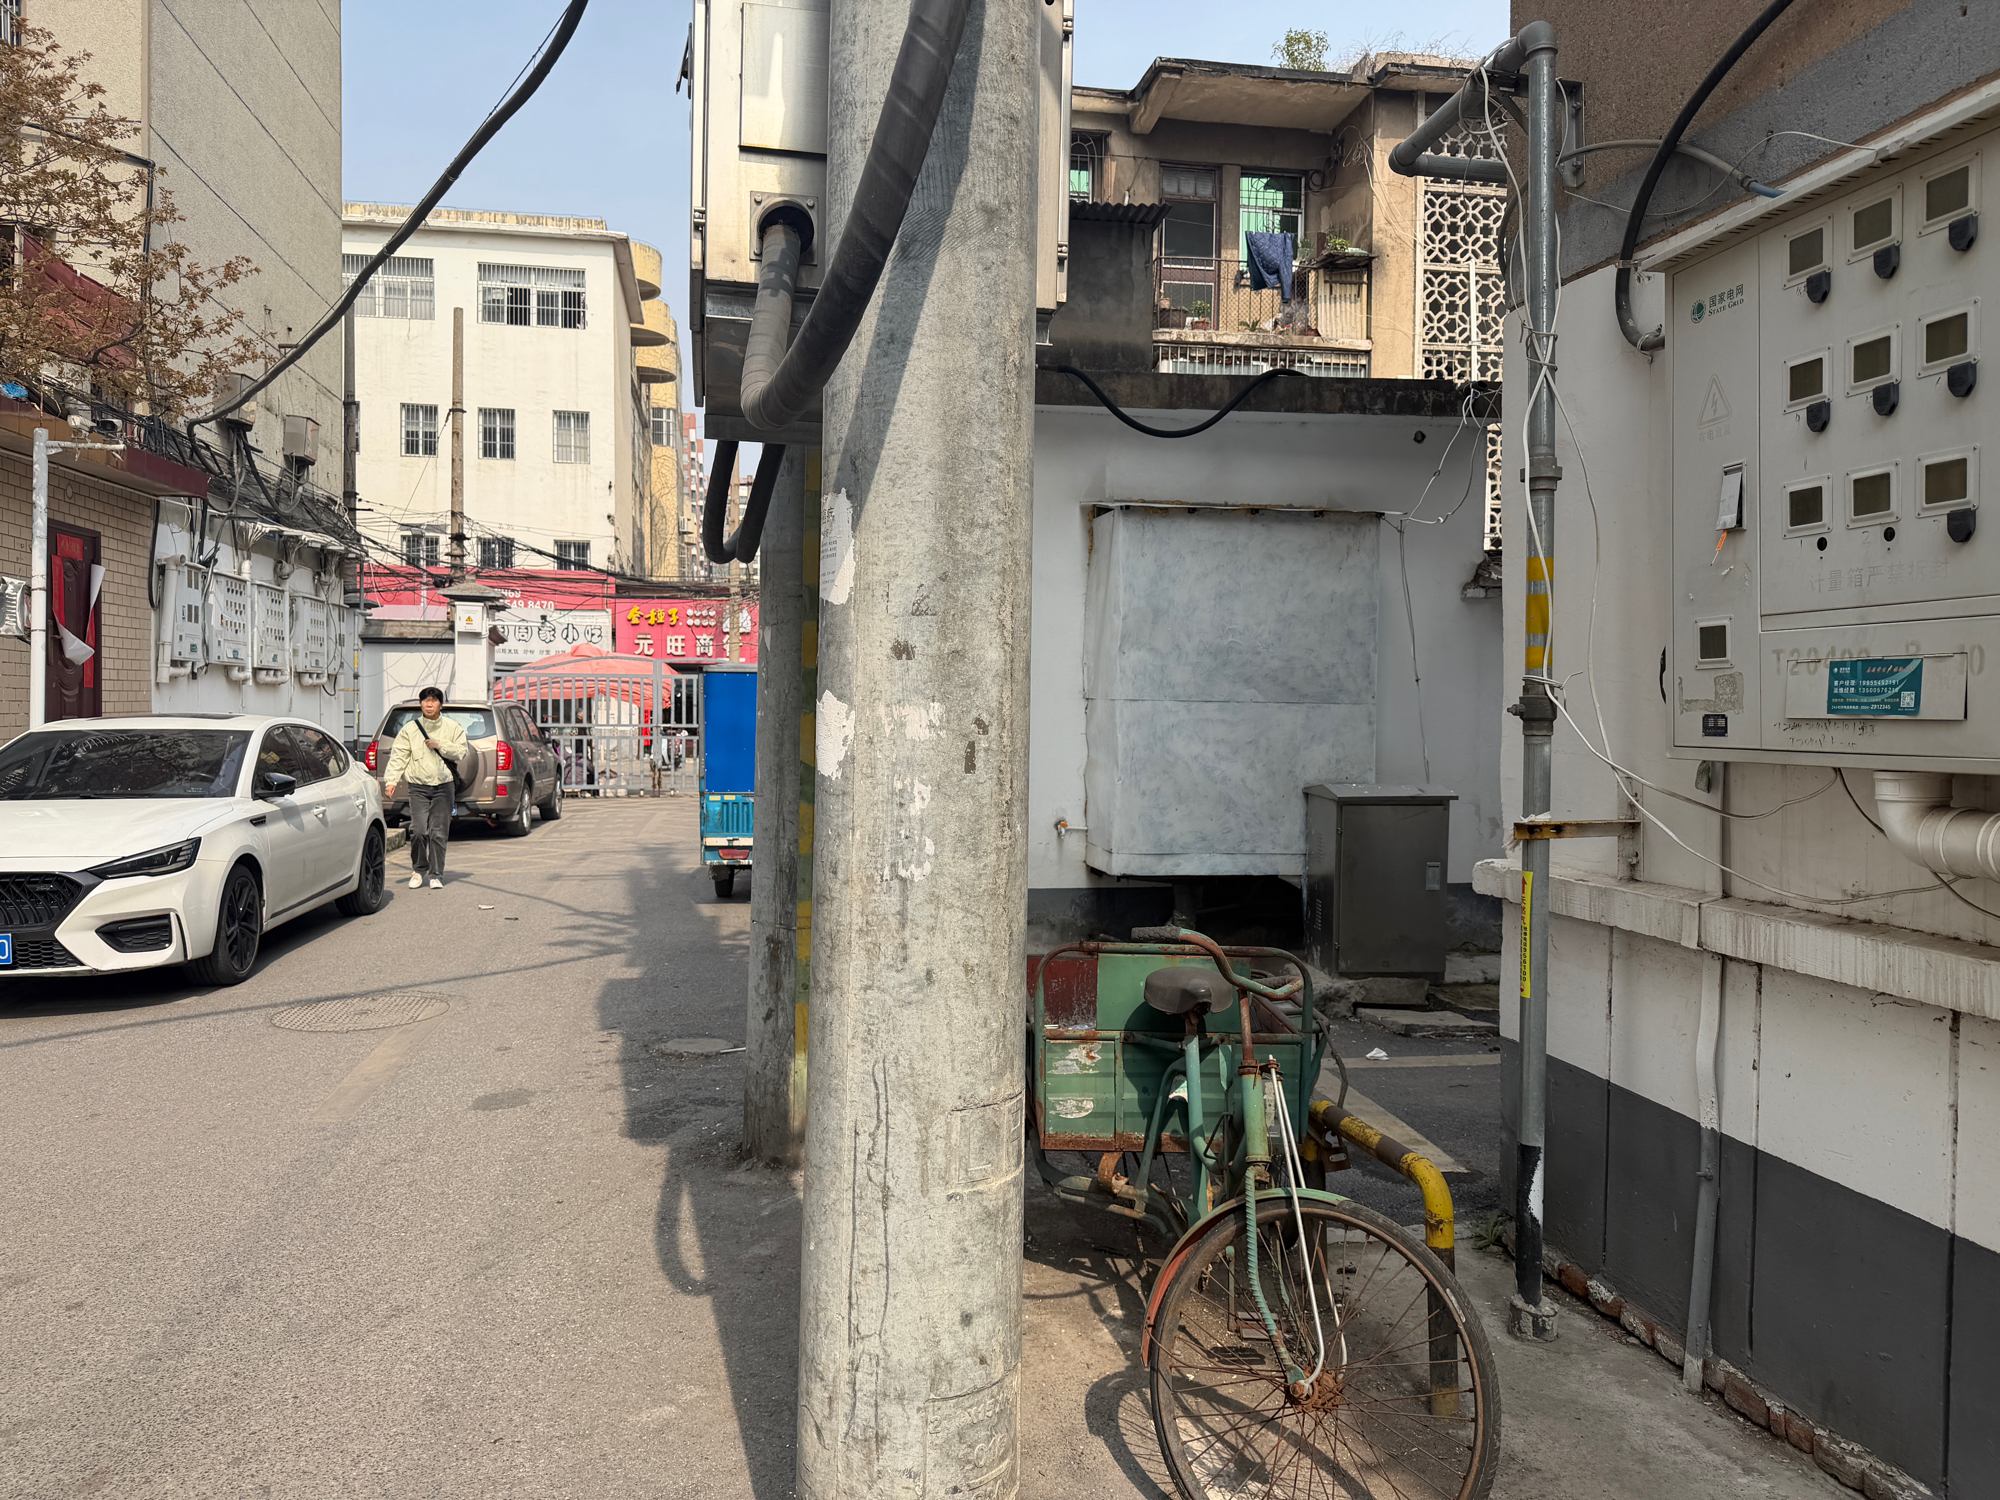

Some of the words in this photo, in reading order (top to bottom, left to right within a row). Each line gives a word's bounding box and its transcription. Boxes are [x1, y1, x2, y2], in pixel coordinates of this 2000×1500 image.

[1708, 283, 1744, 309] 国家电网
[1808, 557, 1950, 594] 计量箱严禁拆封
